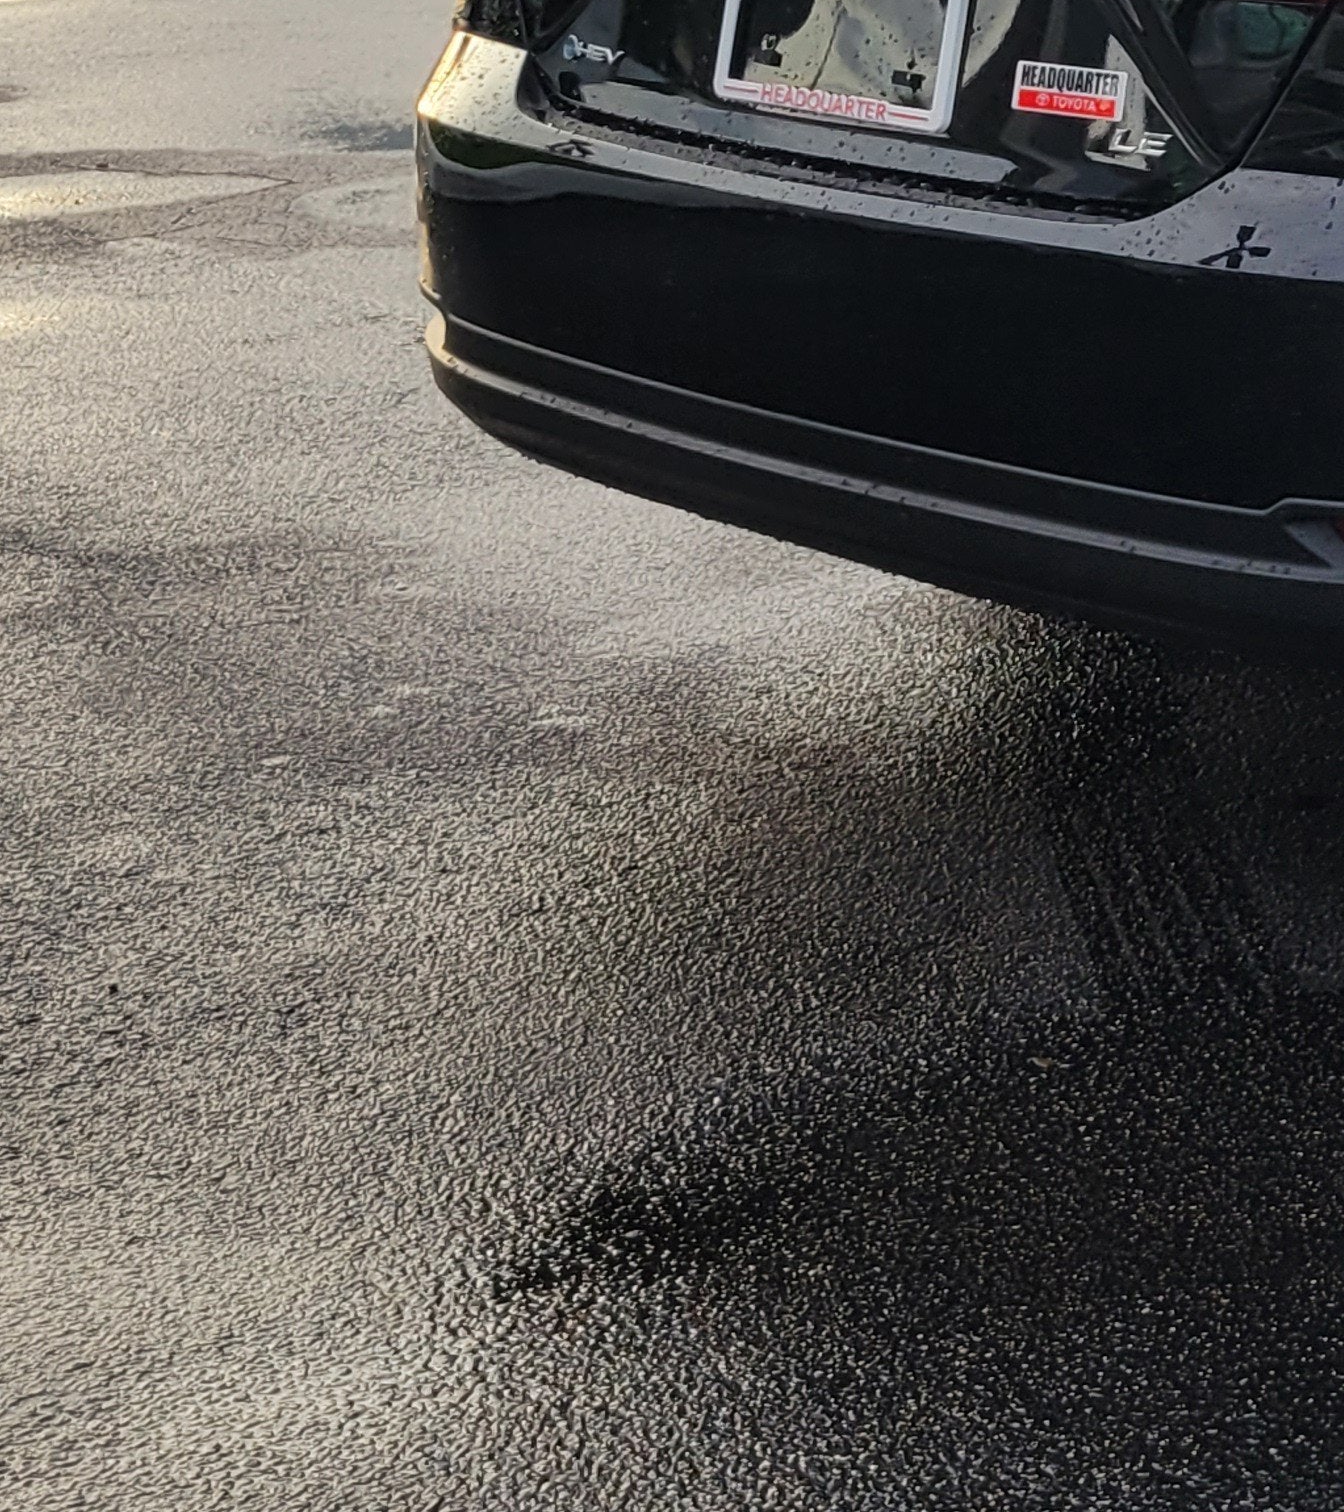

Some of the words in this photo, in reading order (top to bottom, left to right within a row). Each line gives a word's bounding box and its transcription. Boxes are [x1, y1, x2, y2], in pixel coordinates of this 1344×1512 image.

[578, 40, 626, 66] HEV
[1020, 64, 1120, 97] HEADQUARTER
[759, 82, 888, 122] HEADQUARTER
[1051, 95, 1097, 113] TOYOTA
[1108, 128, 1174, 157] LE
